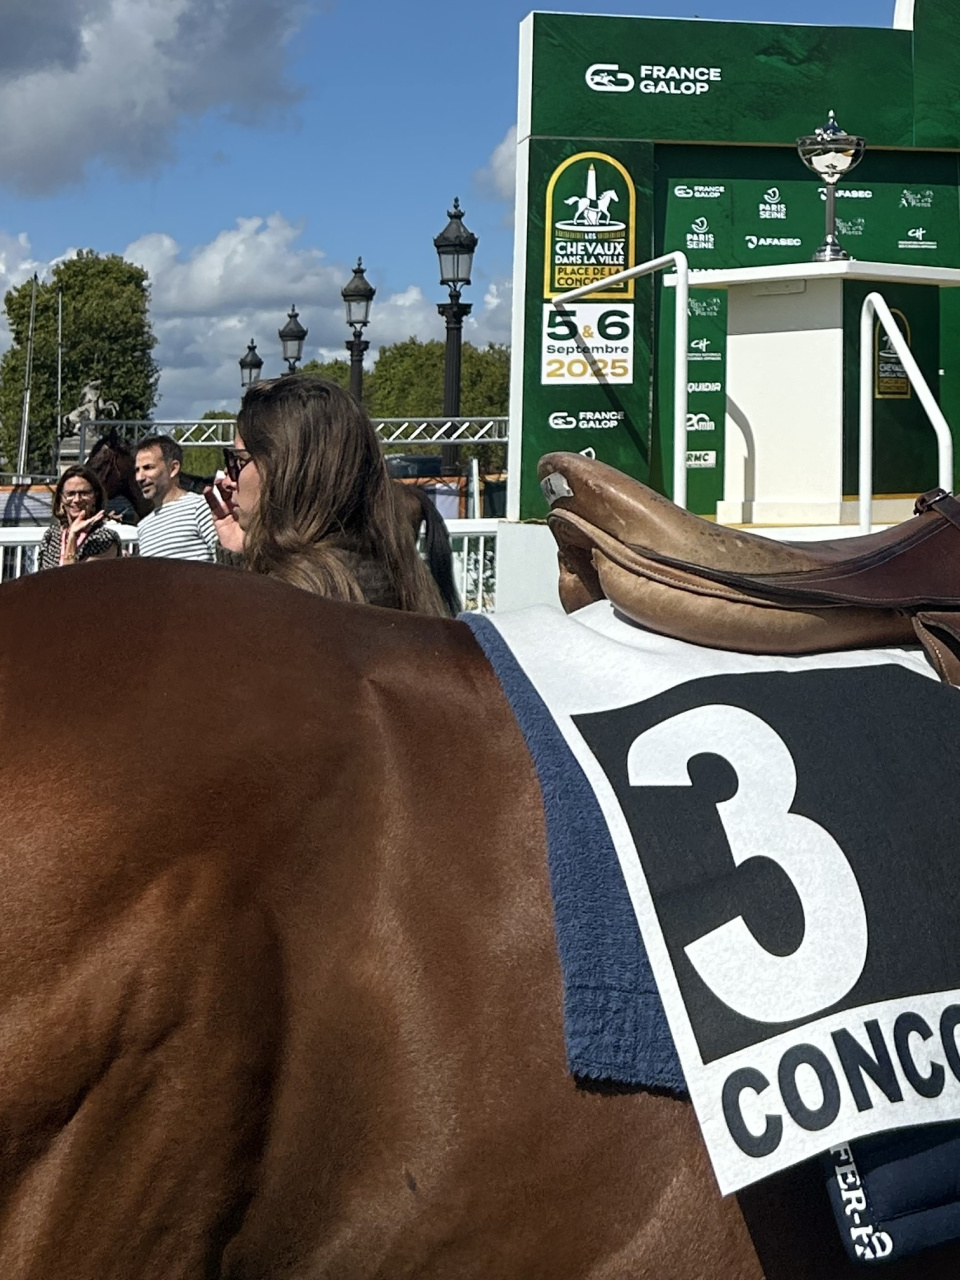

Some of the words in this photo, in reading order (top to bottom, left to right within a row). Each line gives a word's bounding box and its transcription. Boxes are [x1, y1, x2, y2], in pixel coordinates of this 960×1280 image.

[640, 65, 722, 81] FRANCE
[639, 80, 709, 95] GALOP
[759, 211, 787, 219] SEINE
[686, 241, 715, 249] SEINE
[757, 238, 801, 246] AFASEC
[555, 242, 625, 255] CHEVAUX
[555, 255, 582, 264] DANS
[583, 256, 597, 264] LA
[598, 256, 625, 264] VILLE
[558, 267, 590, 276] PLACE
[592, 267, 606, 276] DE
[546, 310, 578, 341] 5
[582, 325, 594, 338] &
[597, 309, 630, 341] 6
[546, 344, 629, 356] Septembre
[546, 358, 629, 378] 2025
[578, 411, 624, 420] FRANCE
[578, 420, 618, 429] GALOP
[626, 704, 869, 1023] 3
